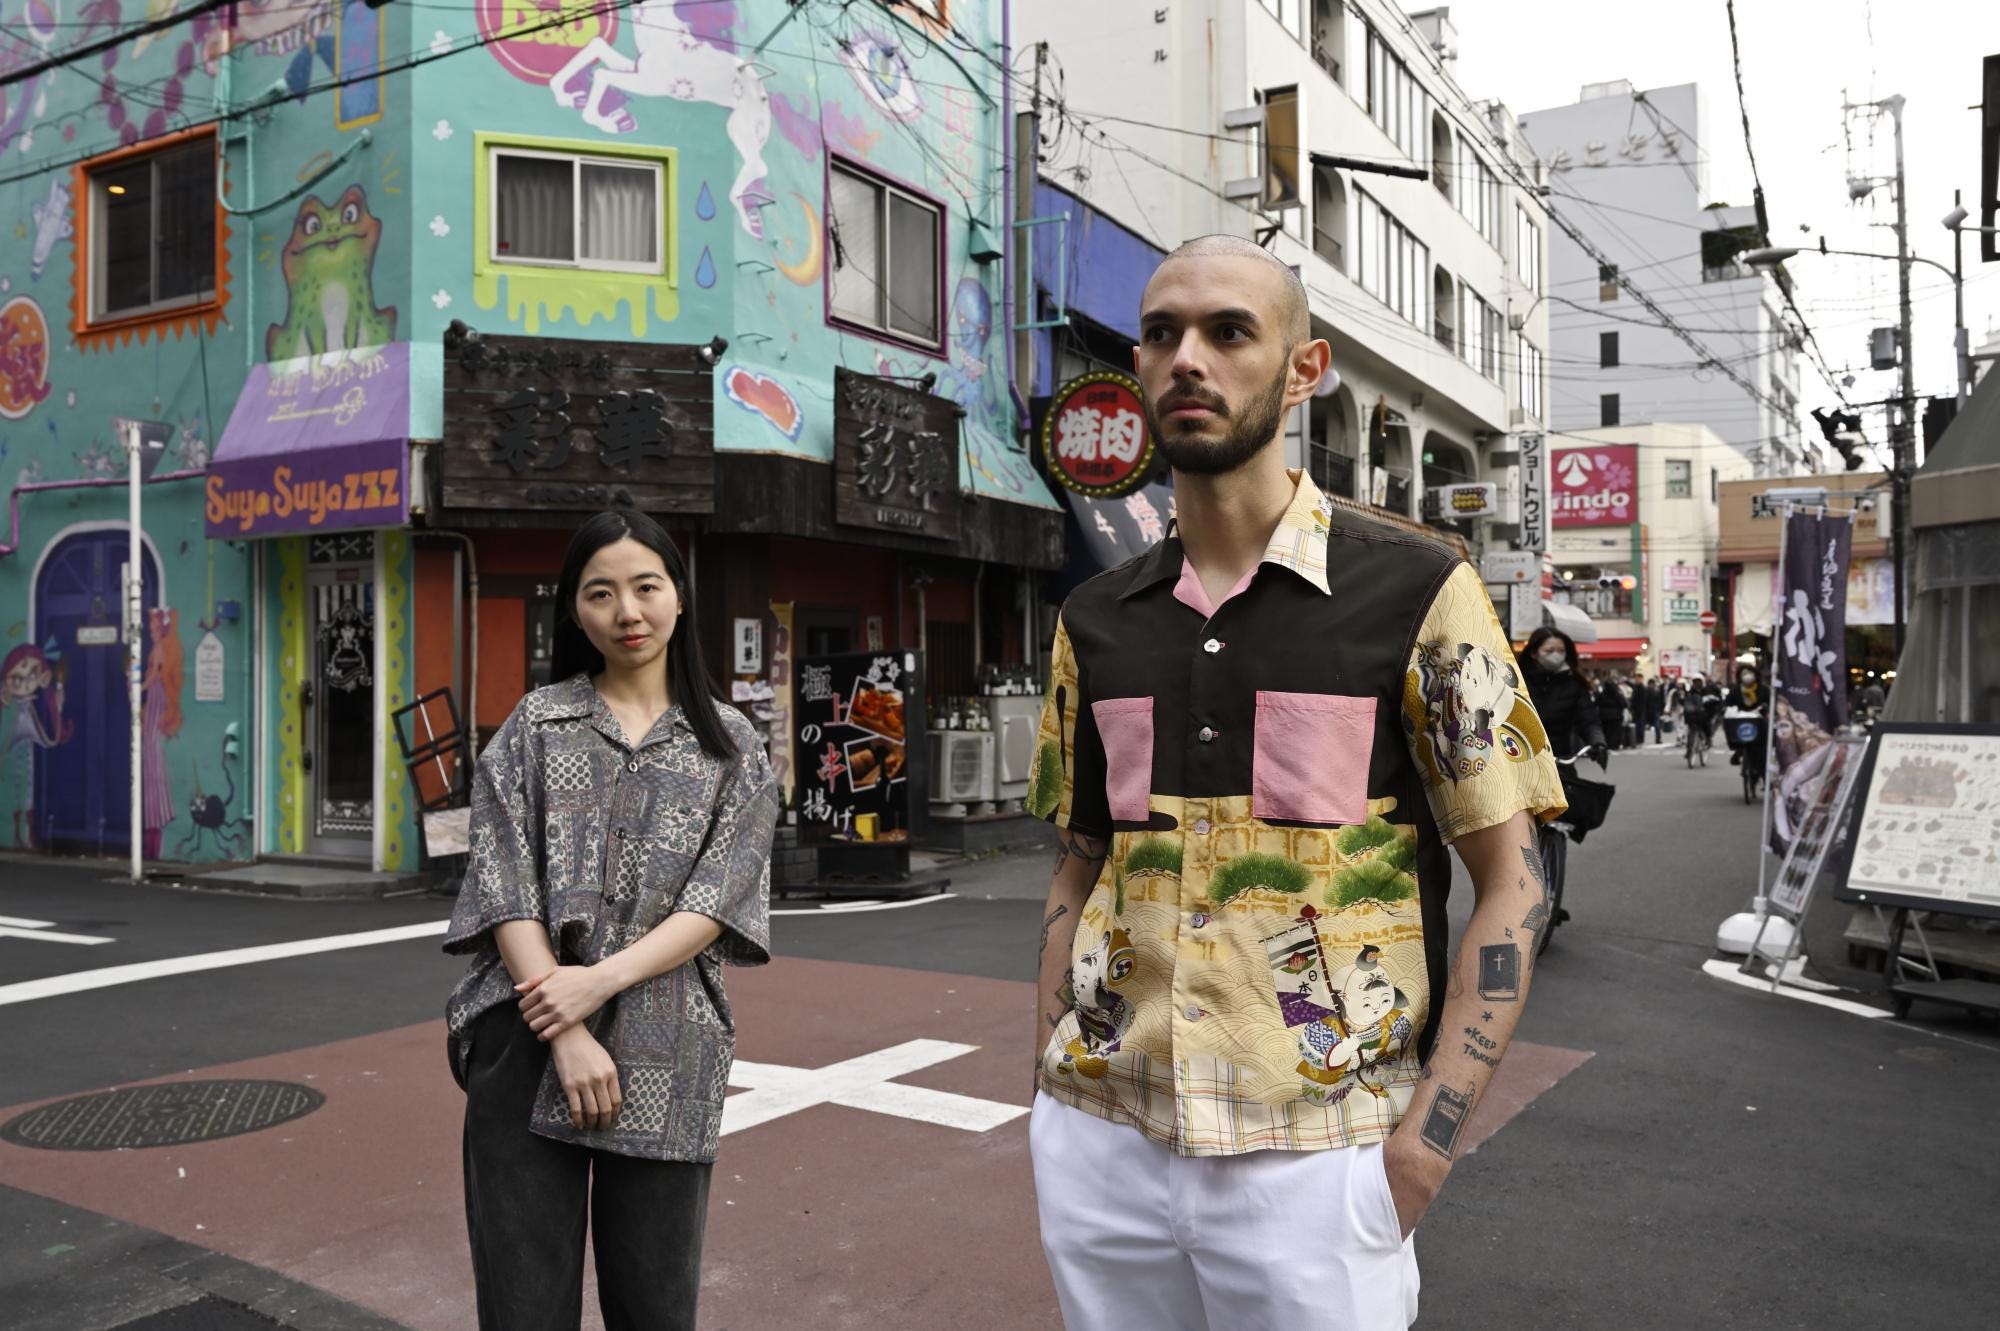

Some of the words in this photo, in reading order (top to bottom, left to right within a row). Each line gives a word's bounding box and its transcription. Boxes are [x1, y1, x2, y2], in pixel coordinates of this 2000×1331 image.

[1058, 406, 1143, 463] 焼肉
[206, 474, 270, 531] Suya
[1521, 438, 1541, 547] ジョートウビル
[1470, 1027, 1497, 1050] KEEP
